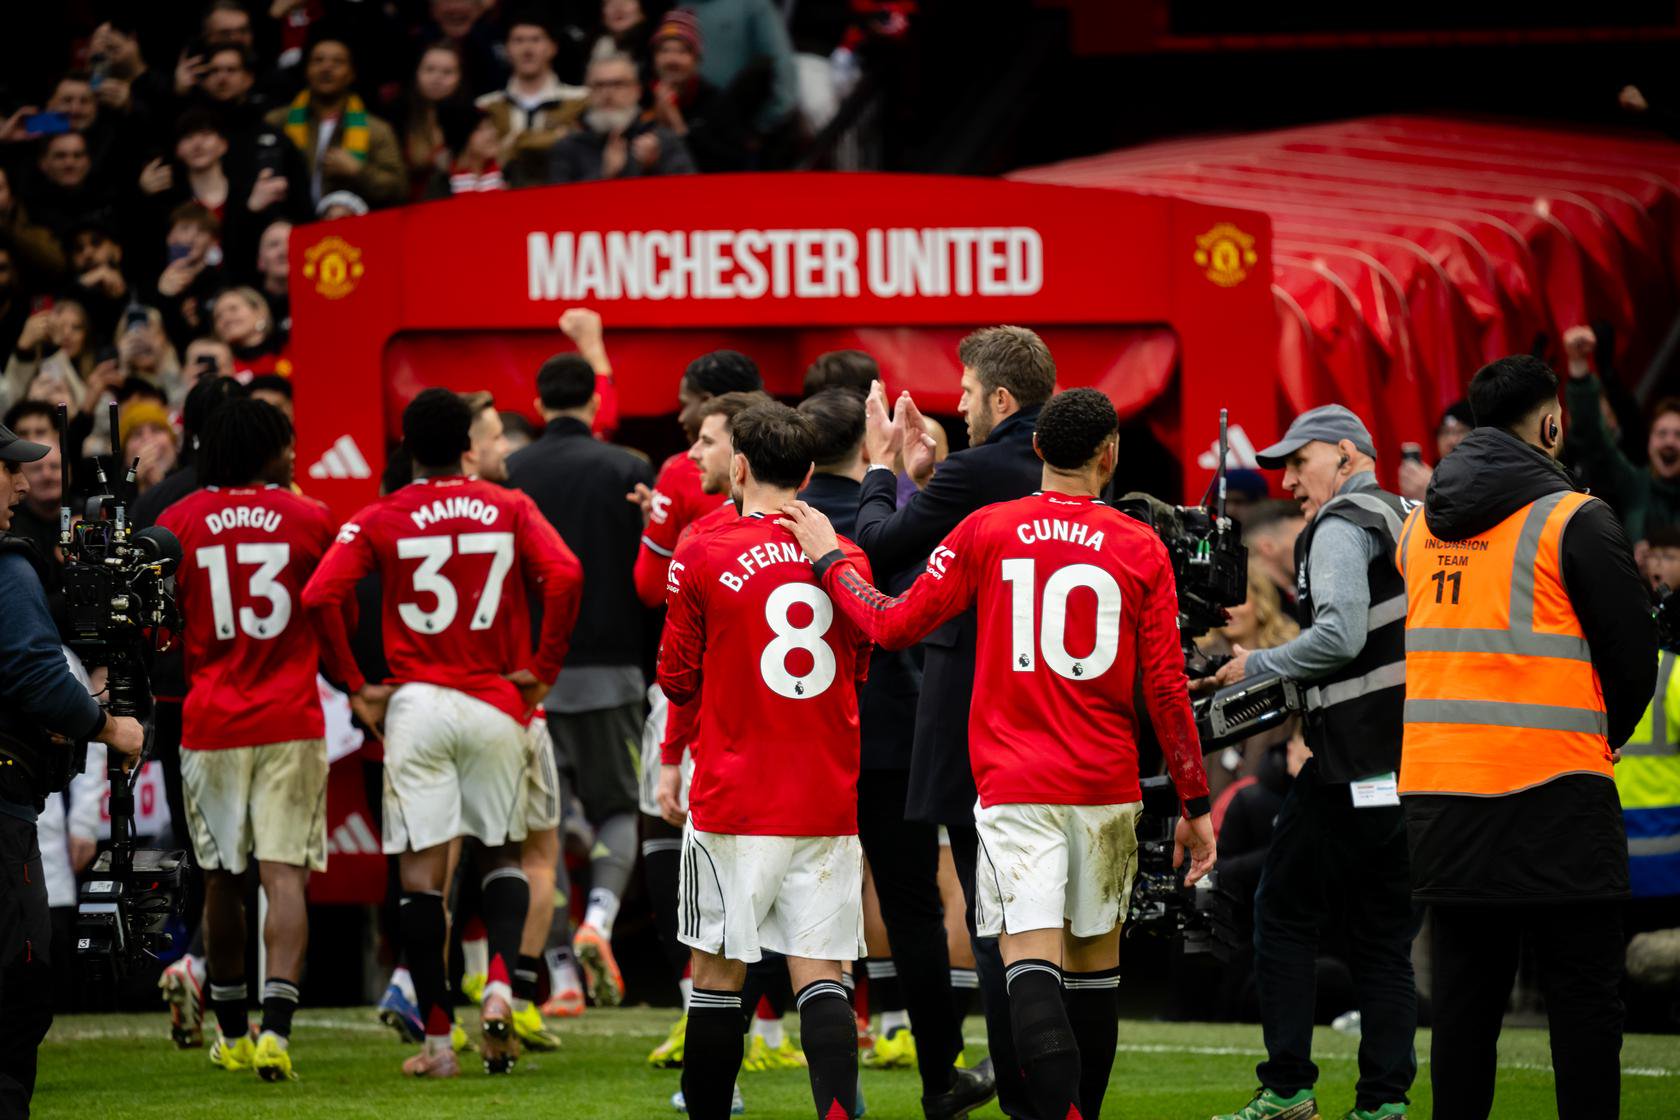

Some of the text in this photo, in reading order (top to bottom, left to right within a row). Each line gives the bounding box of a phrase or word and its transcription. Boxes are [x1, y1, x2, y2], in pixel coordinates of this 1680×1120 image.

[528, 228, 1042, 299] MANCHESTER UNITED
[206, 507, 281, 534] DORGU
[411, 497, 498, 529] MAINOO
[1017, 519, 1104, 551] CUNHA
[397, 532, 514, 634] 37
[719, 542, 814, 592] B.FERNA
[1438, 555, 1469, 566] TEAM
[196, 543, 290, 639] 13
[1432, 570, 1462, 605] 11
[760, 582, 836, 699] 8
[1002, 558, 1121, 680] 10
